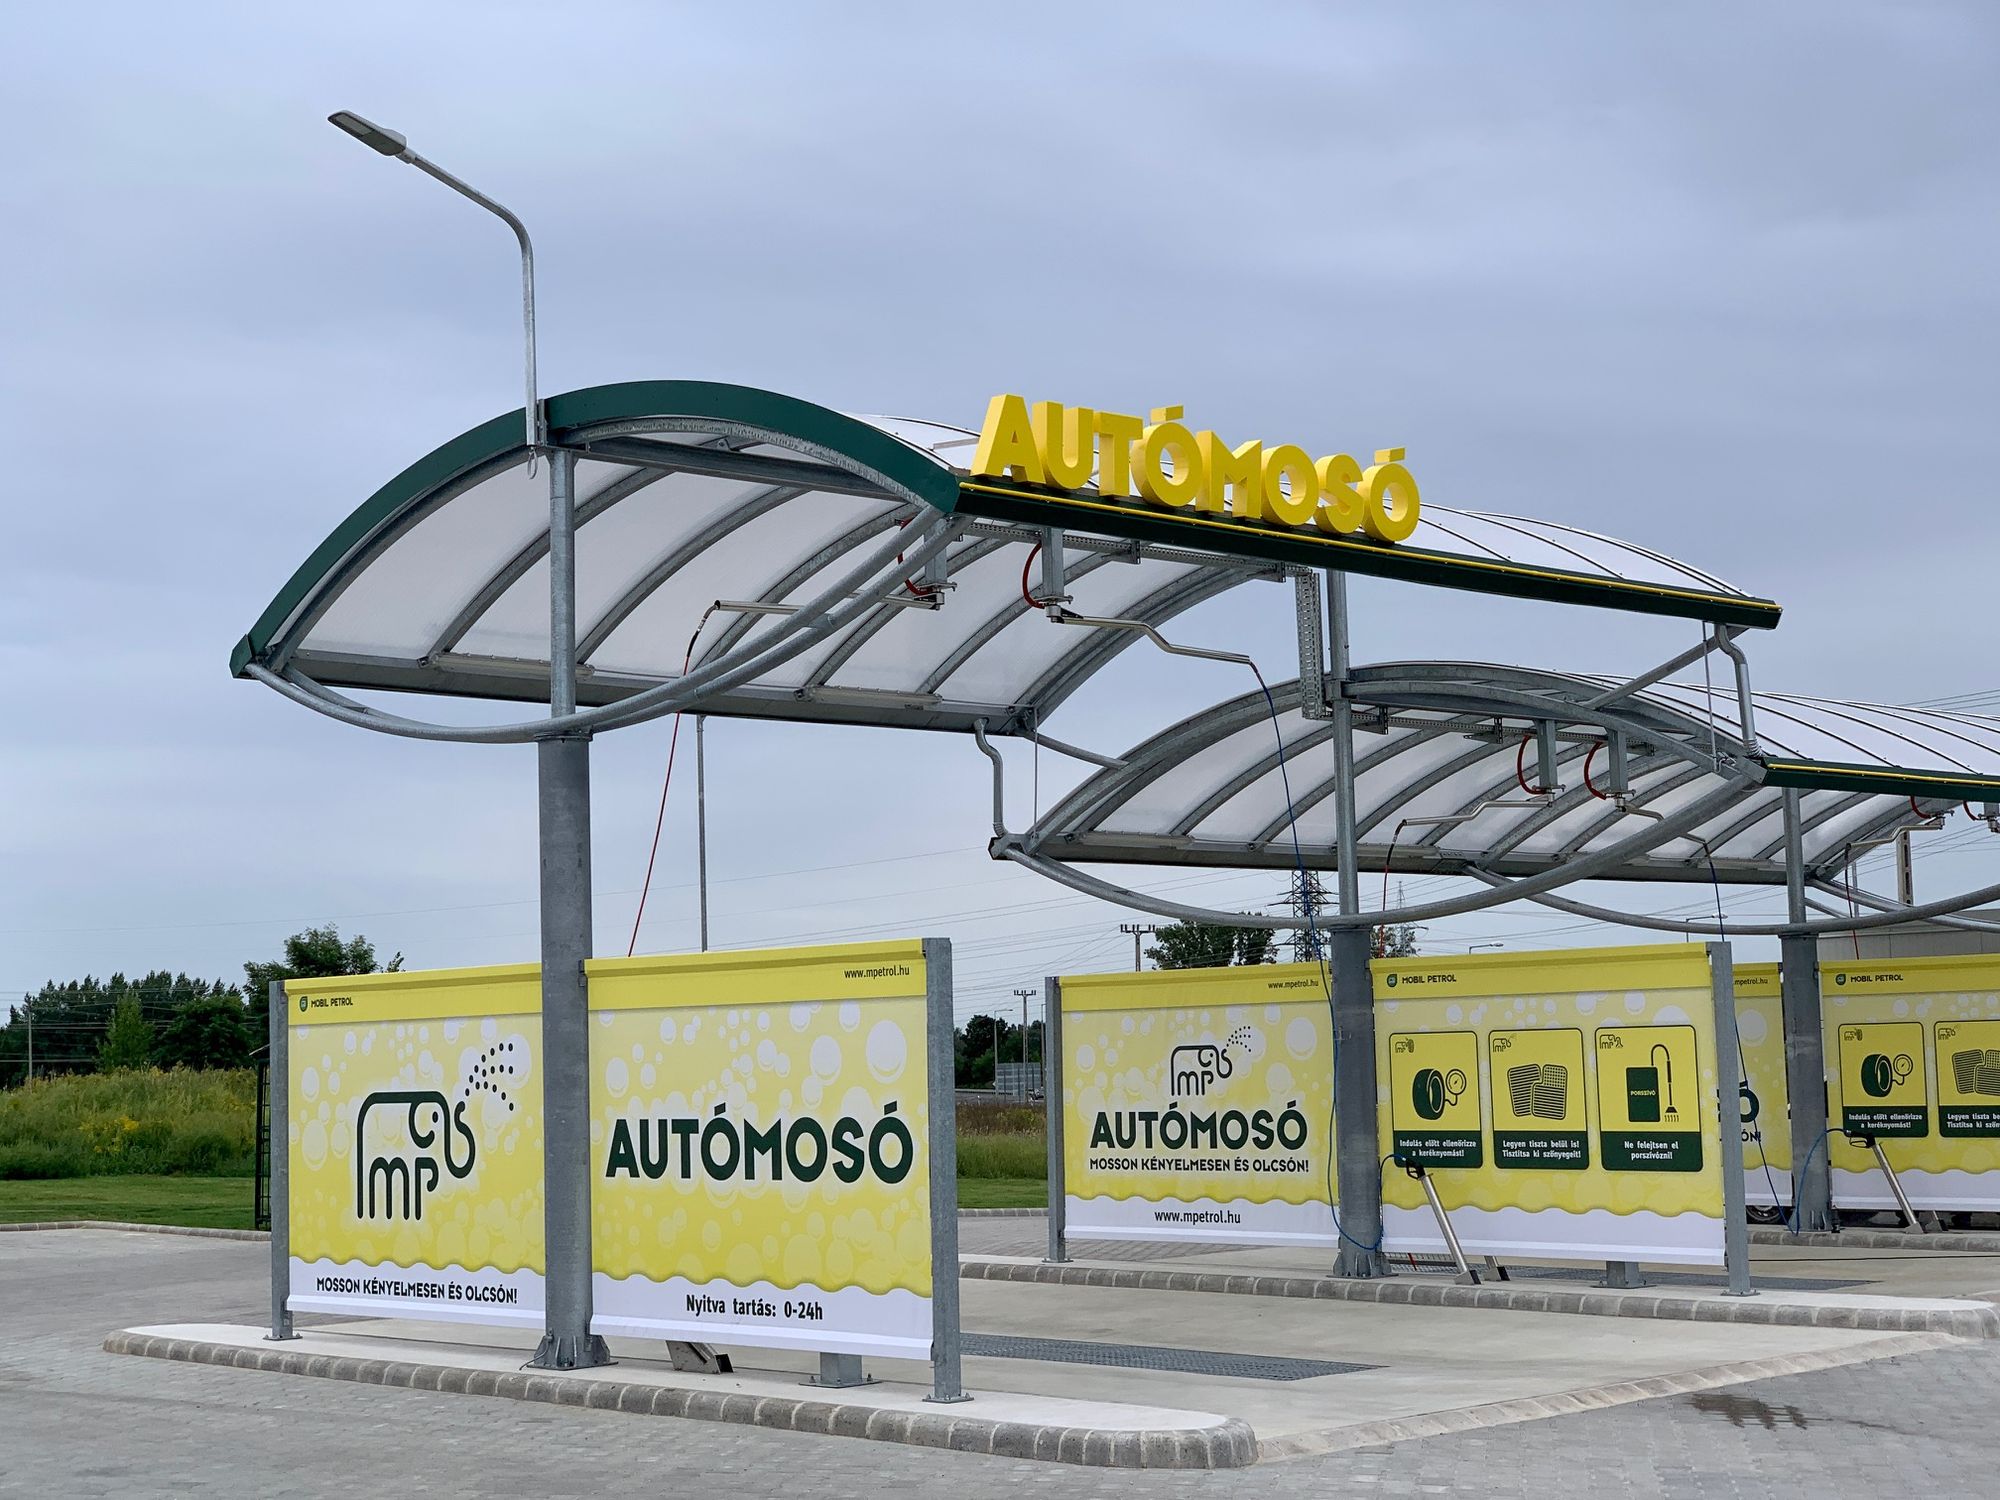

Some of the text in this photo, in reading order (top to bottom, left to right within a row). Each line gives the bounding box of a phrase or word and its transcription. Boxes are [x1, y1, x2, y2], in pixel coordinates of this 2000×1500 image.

[969, 394, 1420, 543] AUTÓMOSÓ
[843, 964, 910, 980] www.mpetrol.hu
[1401, 974, 1457, 984] MOBIL PETROL
[1850, 974, 1904, 983] MOBIL PETROL
[1268, 979, 1319, 990] www.mpetrol.hu
[311, 997, 353, 1008] MOBIL PETROL
[1090, 1100, 1308, 1151] AUTÓMOSÓ
[606, 1100, 914, 1185] AUTÓMOSÓ
[1400, 1139, 1423, 1147] Indulás
[1502, 1139, 1580, 1149] Legyen tiszta belül is!
[1624, 1140, 1679, 1151] Ne felejtsen el
[1418, 1149, 1464, 1158] keréknyomást!
[1533, 1149, 1540, 1158] ki
[1631, 1151, 1673, 1161] porszívózni!
[1089, 1155, 1309, 1173] MOSSON KÉNYELMESEN ÉS OLCSÓN!
[1154, 1209, 1241, 1226] www.mpetrol.hu
[316, 1276, 518, 1305] MOSSON KÉNYELMESEN ÉS OLCSÓN!
[686, 1294, 823, 1321] Nyitva tartás: 0-24h
